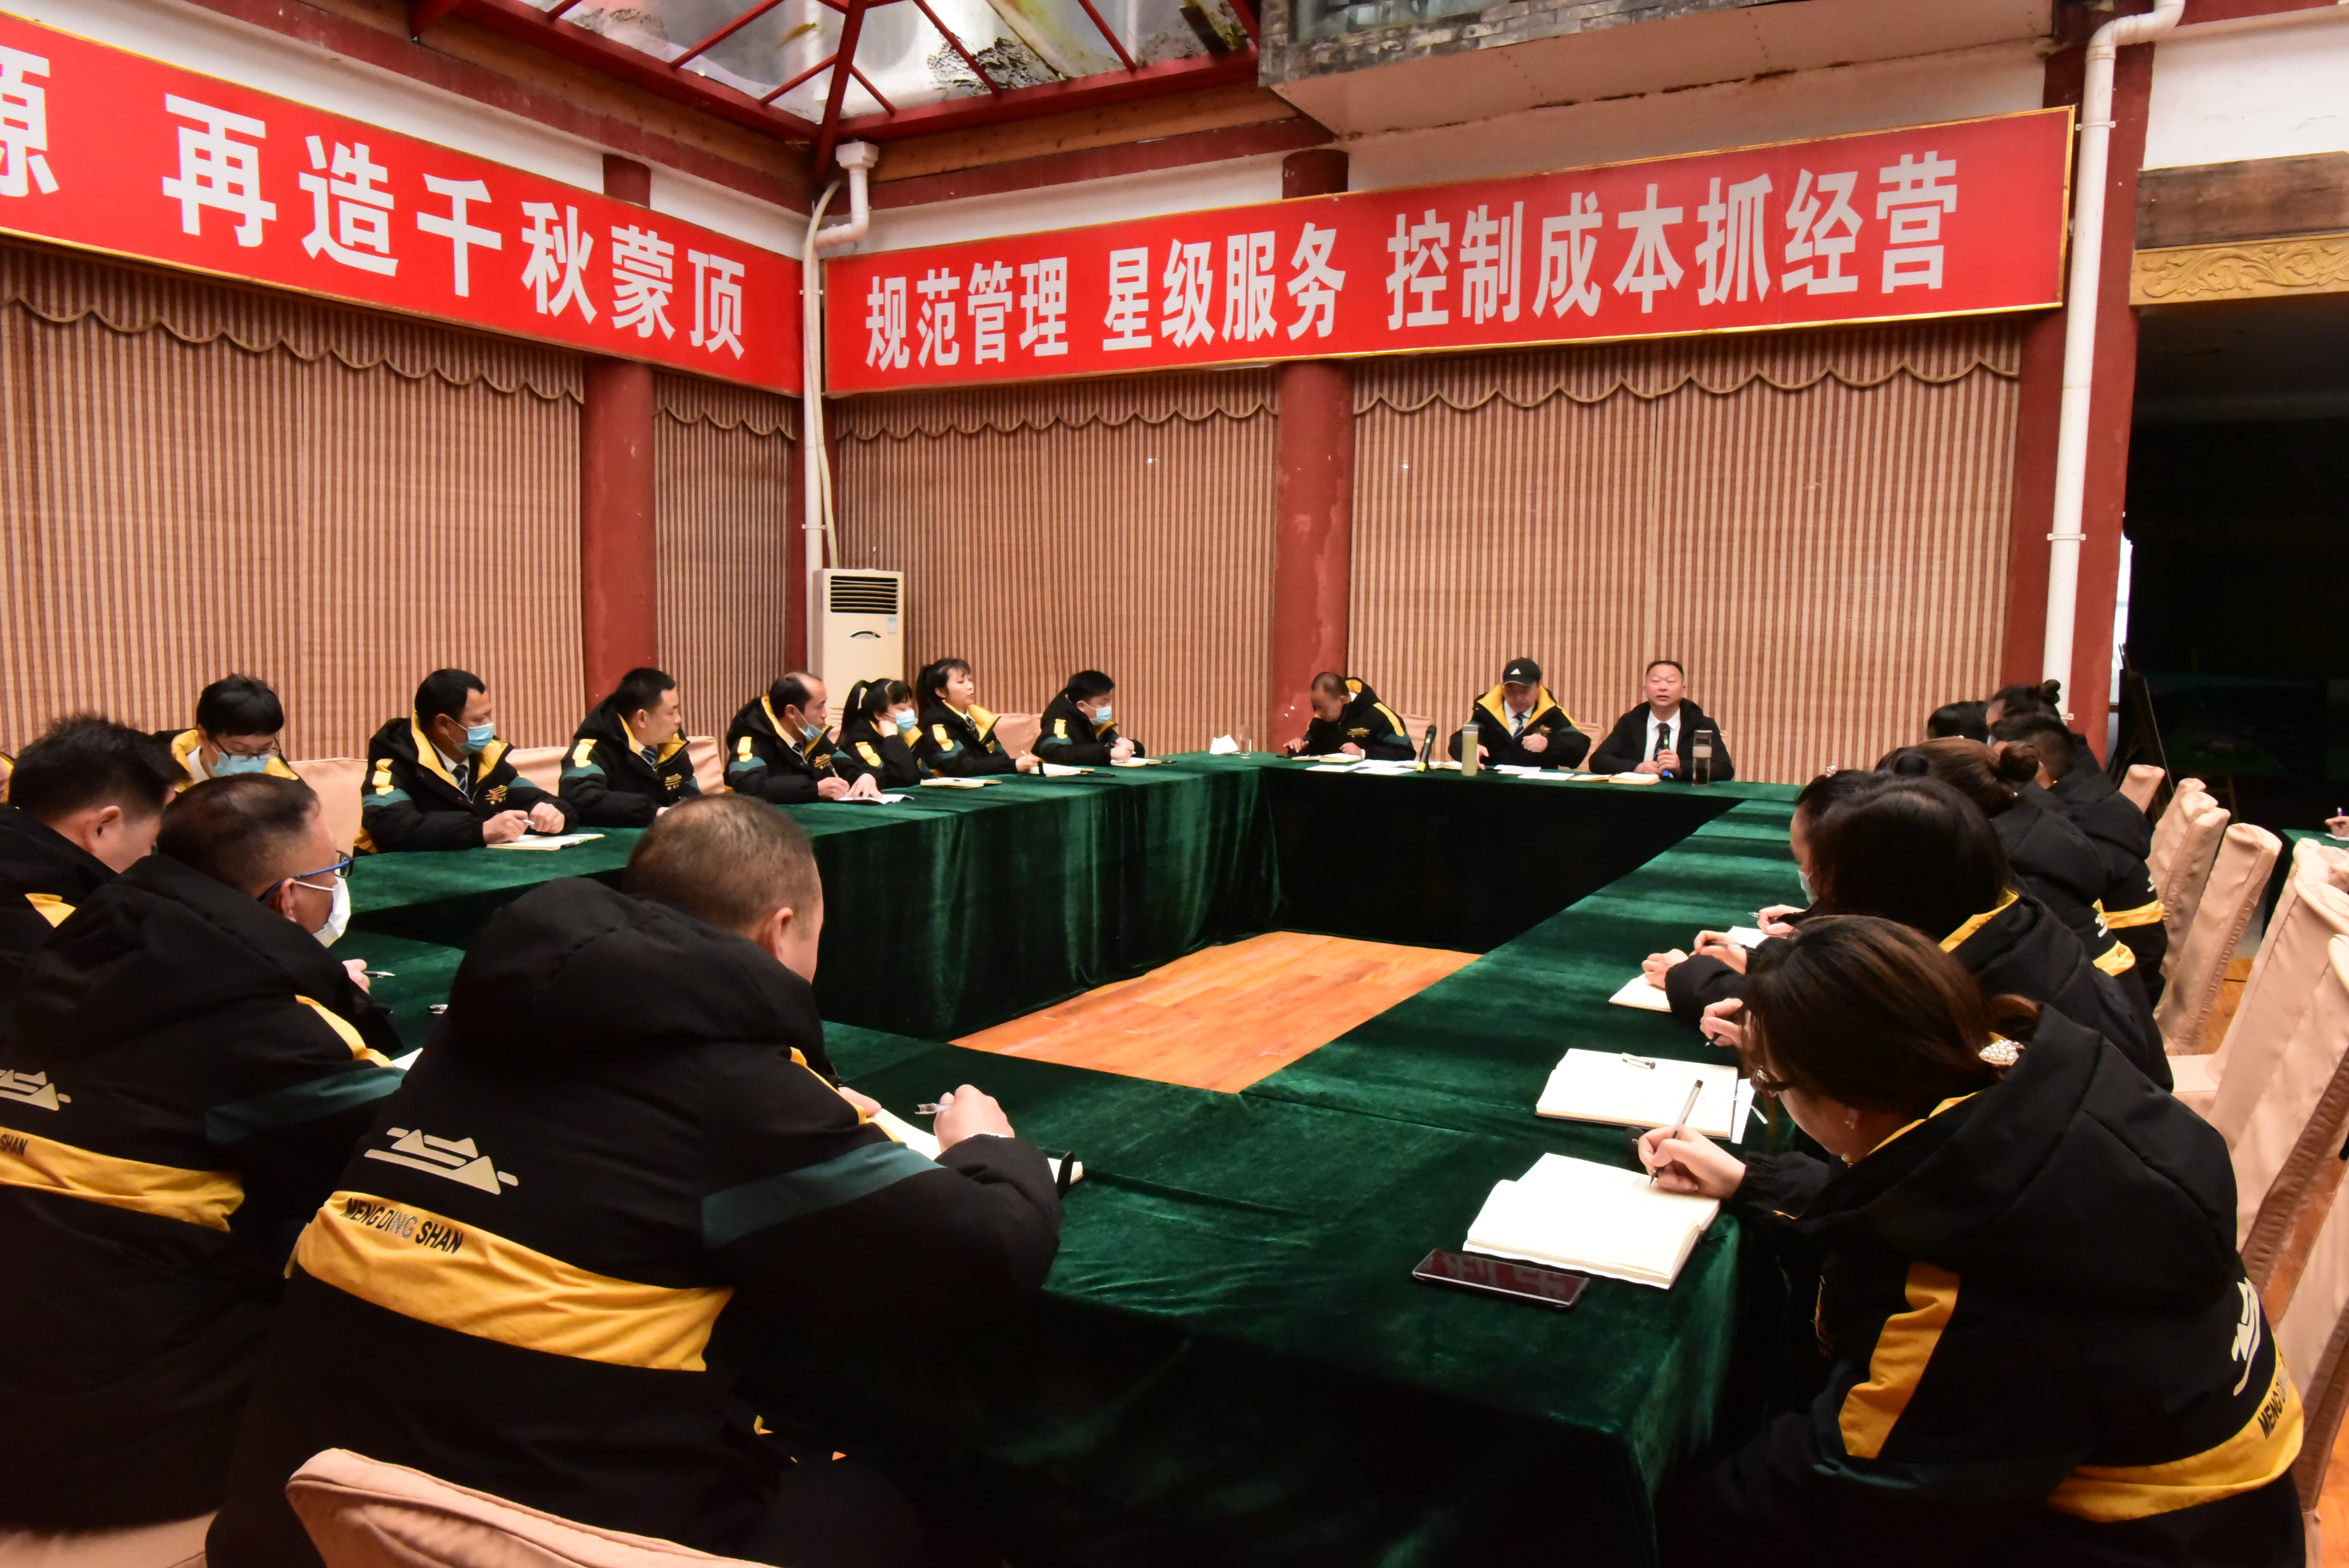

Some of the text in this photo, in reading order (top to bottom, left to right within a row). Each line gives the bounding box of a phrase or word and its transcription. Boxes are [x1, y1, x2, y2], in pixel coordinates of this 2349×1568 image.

[162, 93, 745, 360] 再造千秋蒙顶
[865, 150, 1957, 372] 规范管理 星级服务 控制成本抓经营
[339, 1197, 463, 1254] MENG DING SHAN
